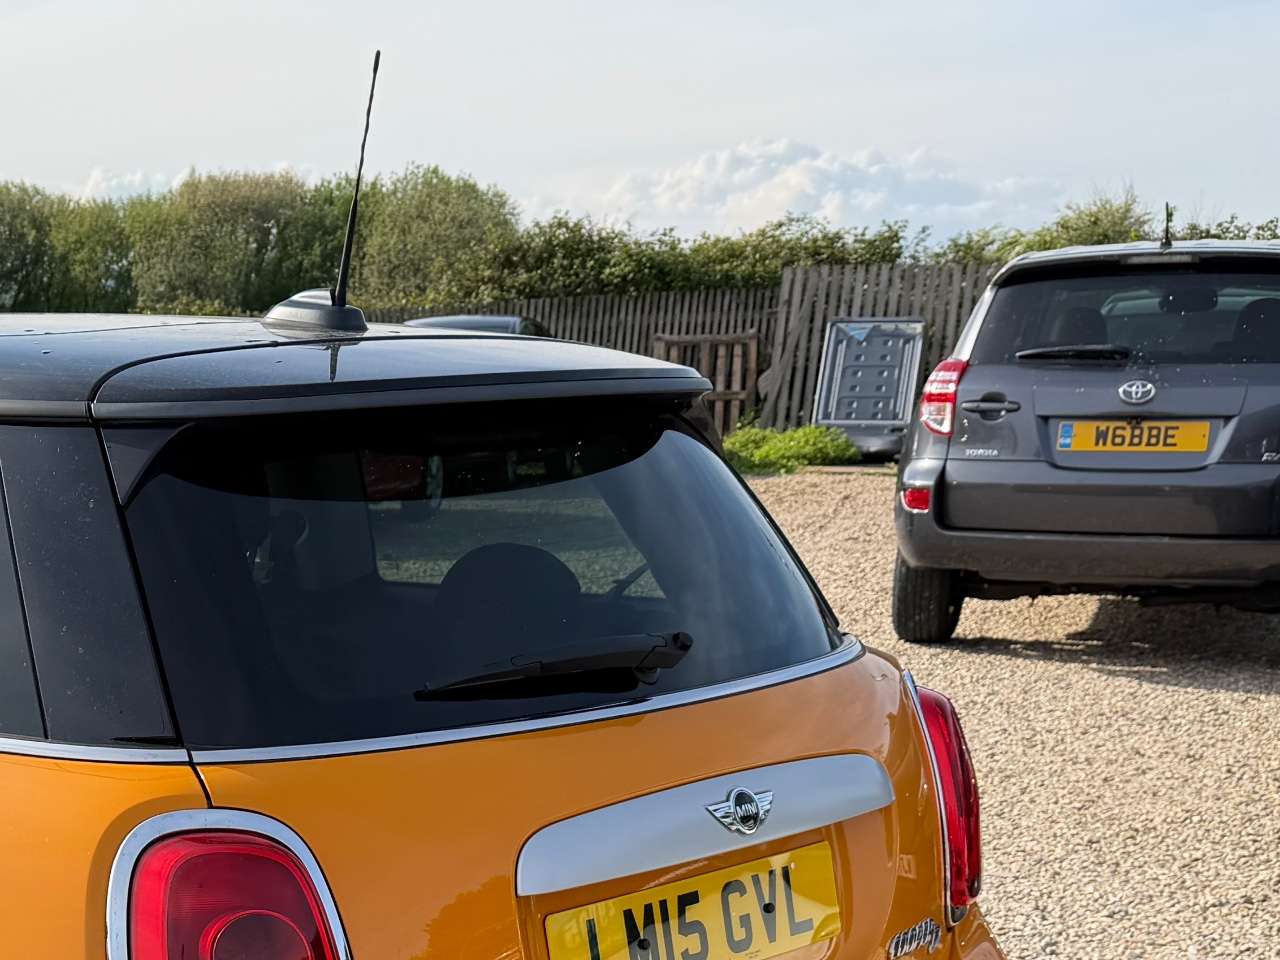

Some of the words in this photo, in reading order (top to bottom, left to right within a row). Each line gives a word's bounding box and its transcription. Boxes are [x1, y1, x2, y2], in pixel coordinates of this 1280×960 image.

[1094, 425, 1180, 447] W6BBE
[736, 802, 758, 818] MINI
[720, 865, 814, 954] GVL
